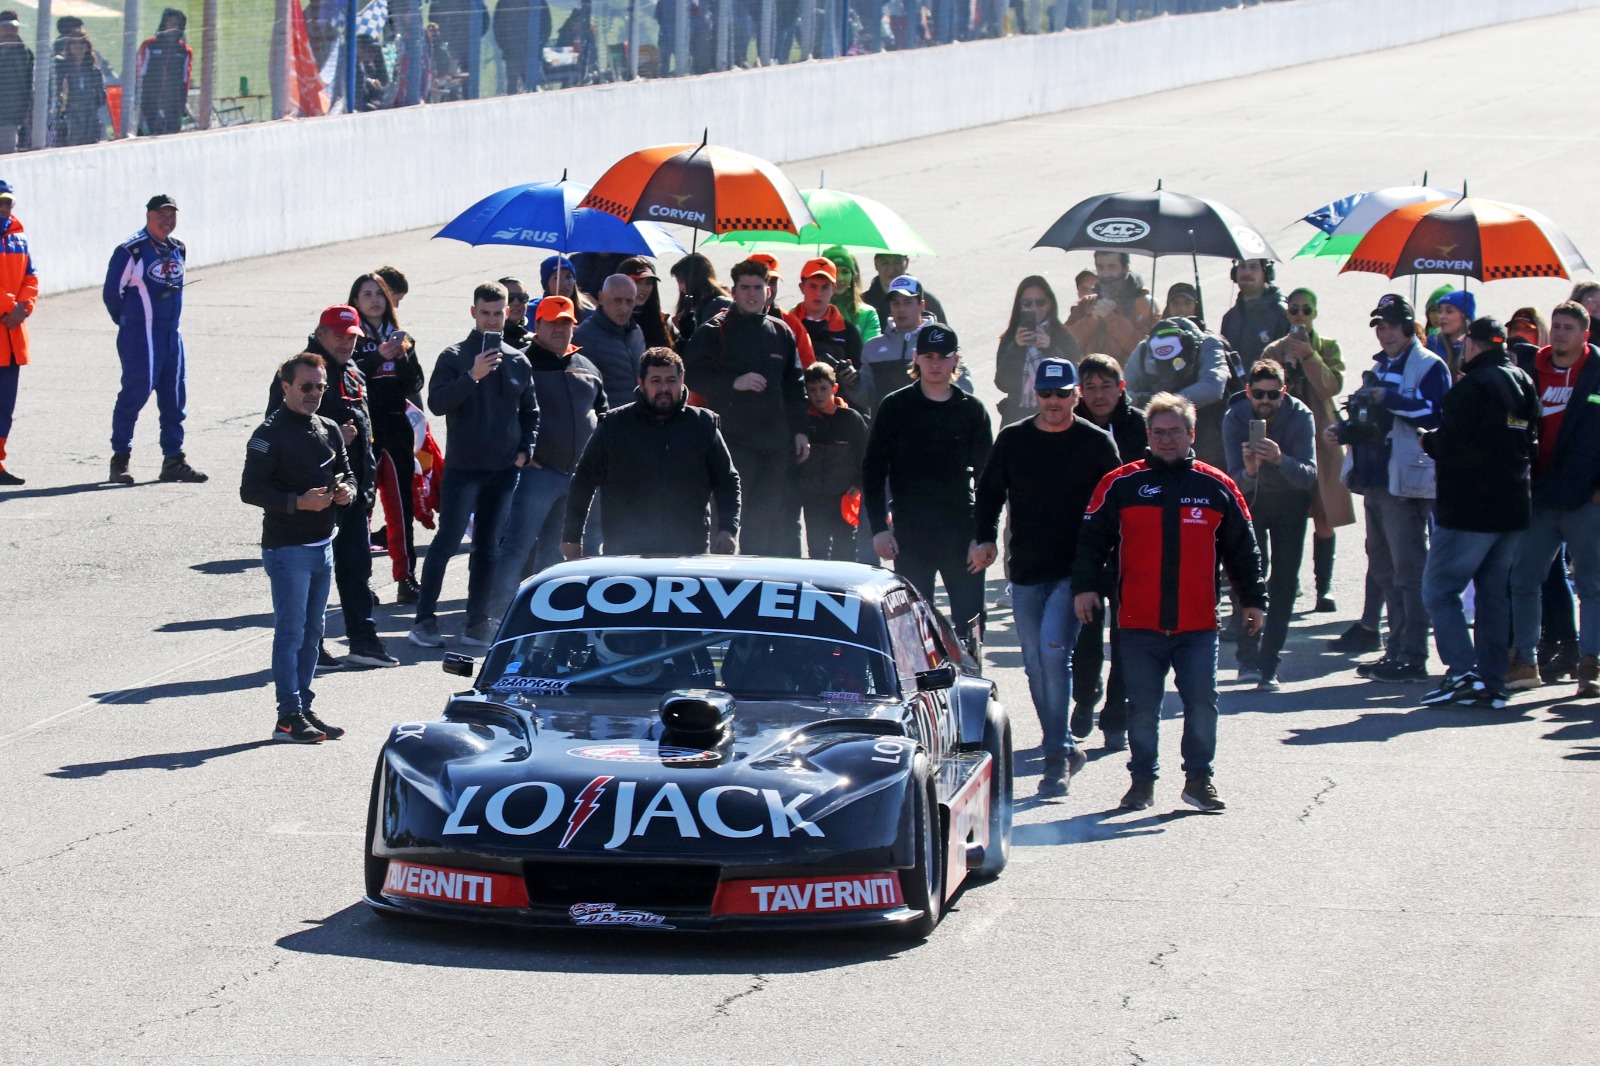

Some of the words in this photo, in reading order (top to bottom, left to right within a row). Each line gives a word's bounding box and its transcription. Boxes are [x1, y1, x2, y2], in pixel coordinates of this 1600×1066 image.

[649, 205, 705, 223] CORVEN
[520, 229, 559, 243] RUS
[1414, 258, 1474, 270] CORVEN
[1541, 386, 1574, 403] NIK
[1194, 497, 1210, 505] JACK
[530, 576, 861, 634] CORVEN
[442, 781, 566, 836] LO
[603, 781, 826, 849] JACK
[751, 878, 896, 912] TAVERNITI
